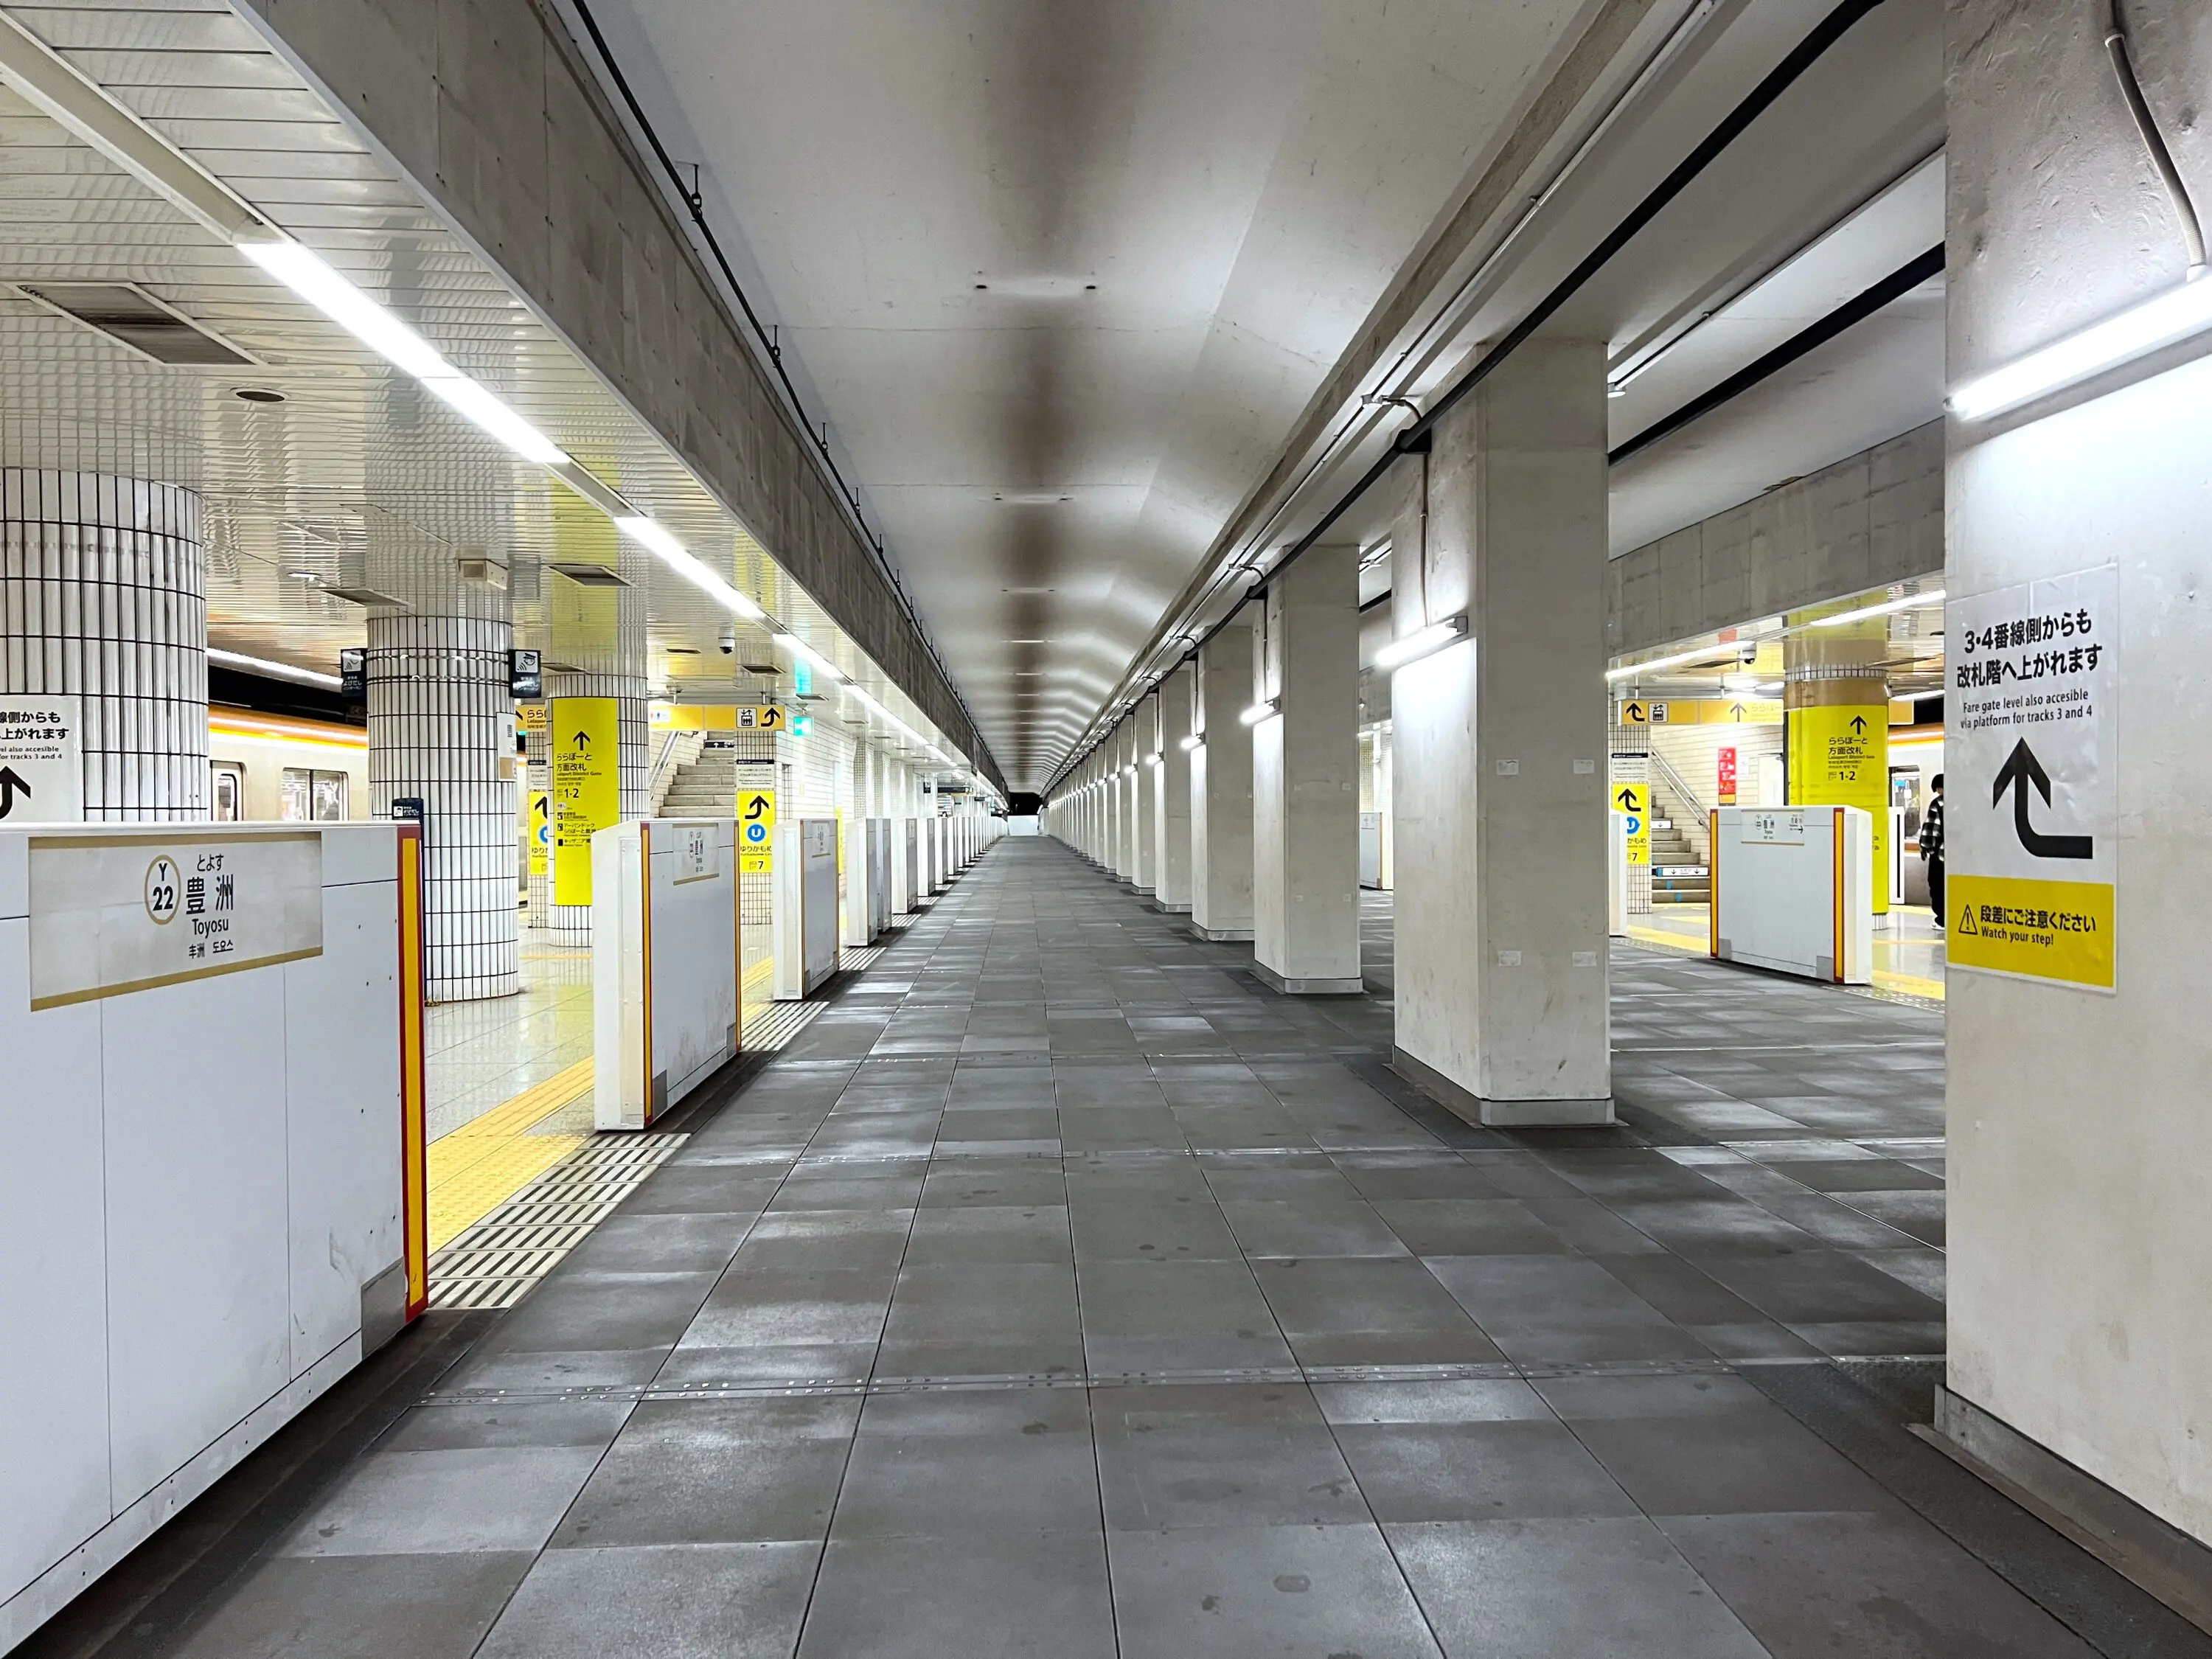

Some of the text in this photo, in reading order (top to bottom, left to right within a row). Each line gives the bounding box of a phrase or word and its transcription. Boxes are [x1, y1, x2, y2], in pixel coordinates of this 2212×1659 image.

[1964, 608, 2092, 653] 3・4番線側からも
[1957, 644, 2102, 688] 改札階へ上がれます
[1964, 688, 2088, 714] Fare gate level also accesible
[1961, 705, 2093, 730] via platform for tracks 3 and 4
[0, 728, 69, 740] 上がれます
[197, 853, 224, 872] とよす
[758, 860, 764, 869] 7
[1632, 852, 1638, 861] 7
[159, 863, 167, 881] Y
[153, 886, 173, 911] 22
[186, 874, 234, 915] 豊洲
[192, 919, 229, 939] Toyosu
[1980, 905, 2096, 933] 段差にご注意ください
[212, 939, 234, 954] 도요스
[1981, 925, 2054, 947] Watch your step!
